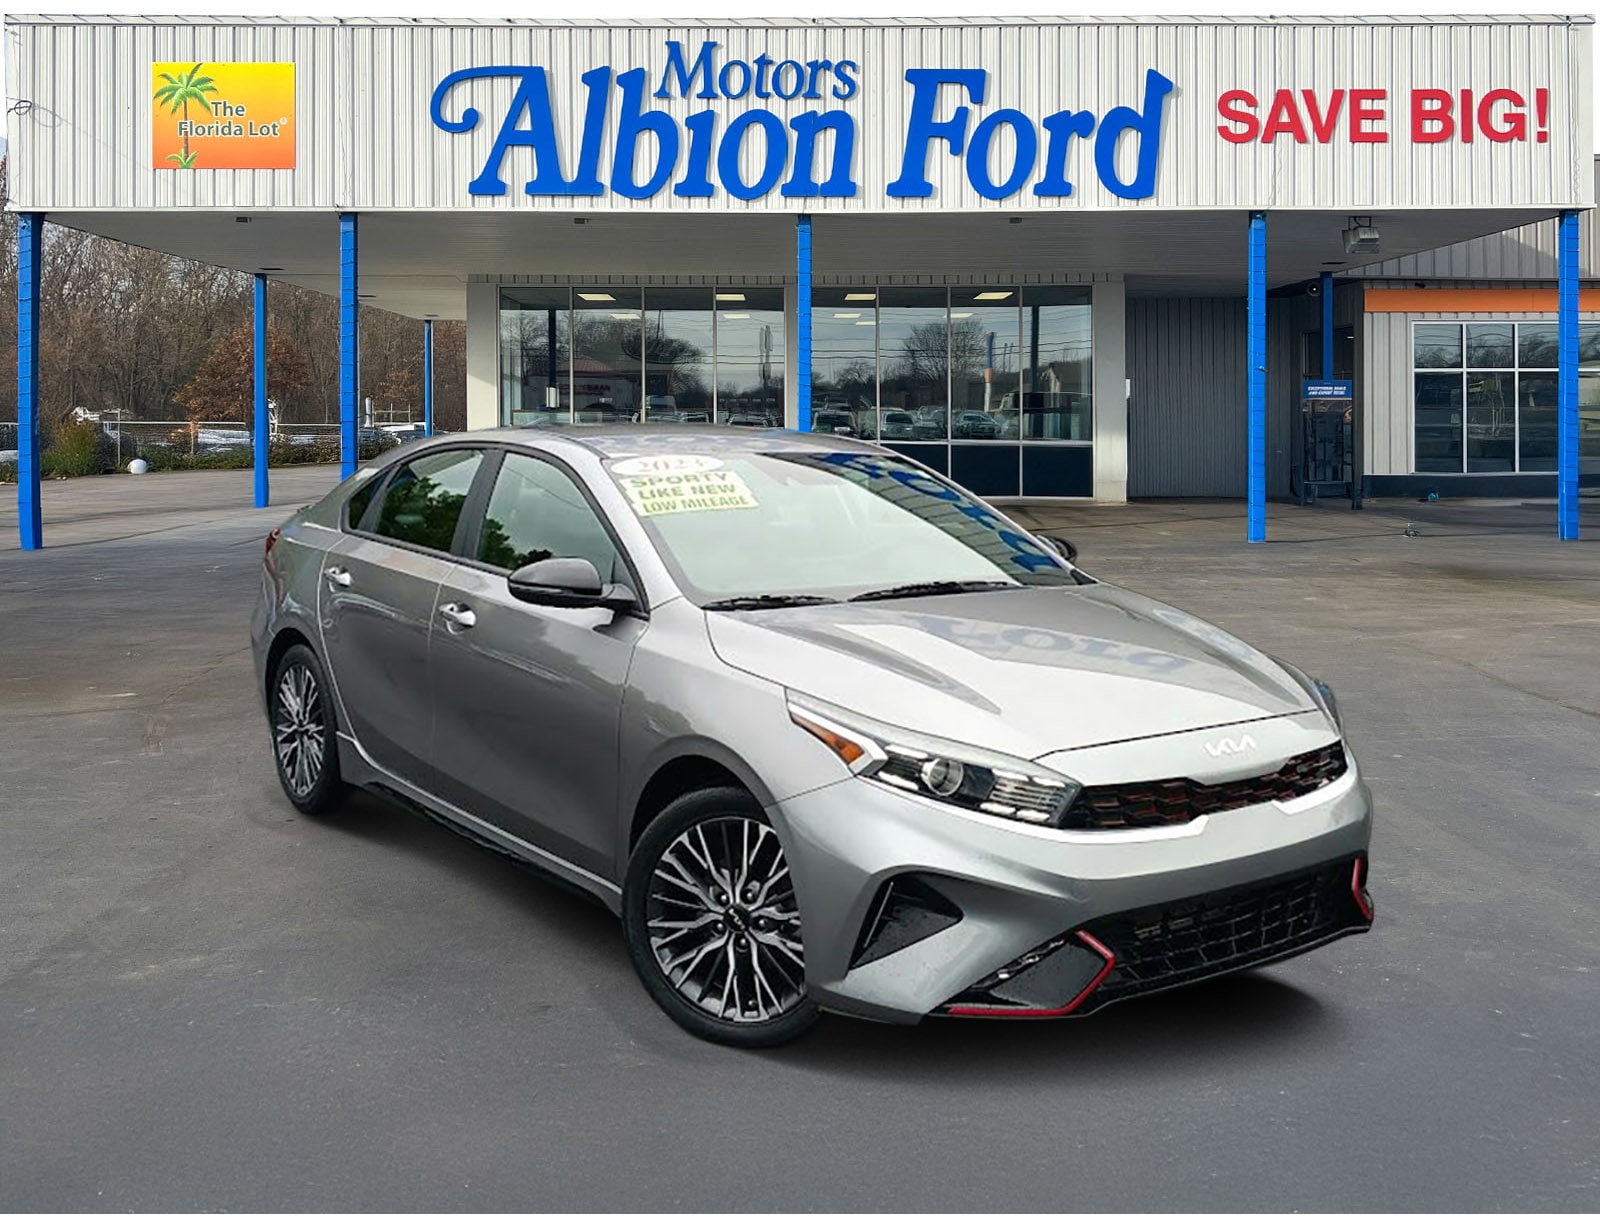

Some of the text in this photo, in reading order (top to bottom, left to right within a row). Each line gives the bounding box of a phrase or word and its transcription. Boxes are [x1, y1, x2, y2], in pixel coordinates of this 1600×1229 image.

[654, 40, 858, 99] Motors
[210, 99, 246, 117] The
[1217, 88, 1549, 143] SAVE BIG!
[177, 120, 279, 137] Florida Lot
[430, 65, 1174, 200] Albion Ford
[630, 472, 728, 489] SPORTY
[638, 483, 736, 500] LIKE NEW
[642, 495, 749, 514] LOW MILEAGE
